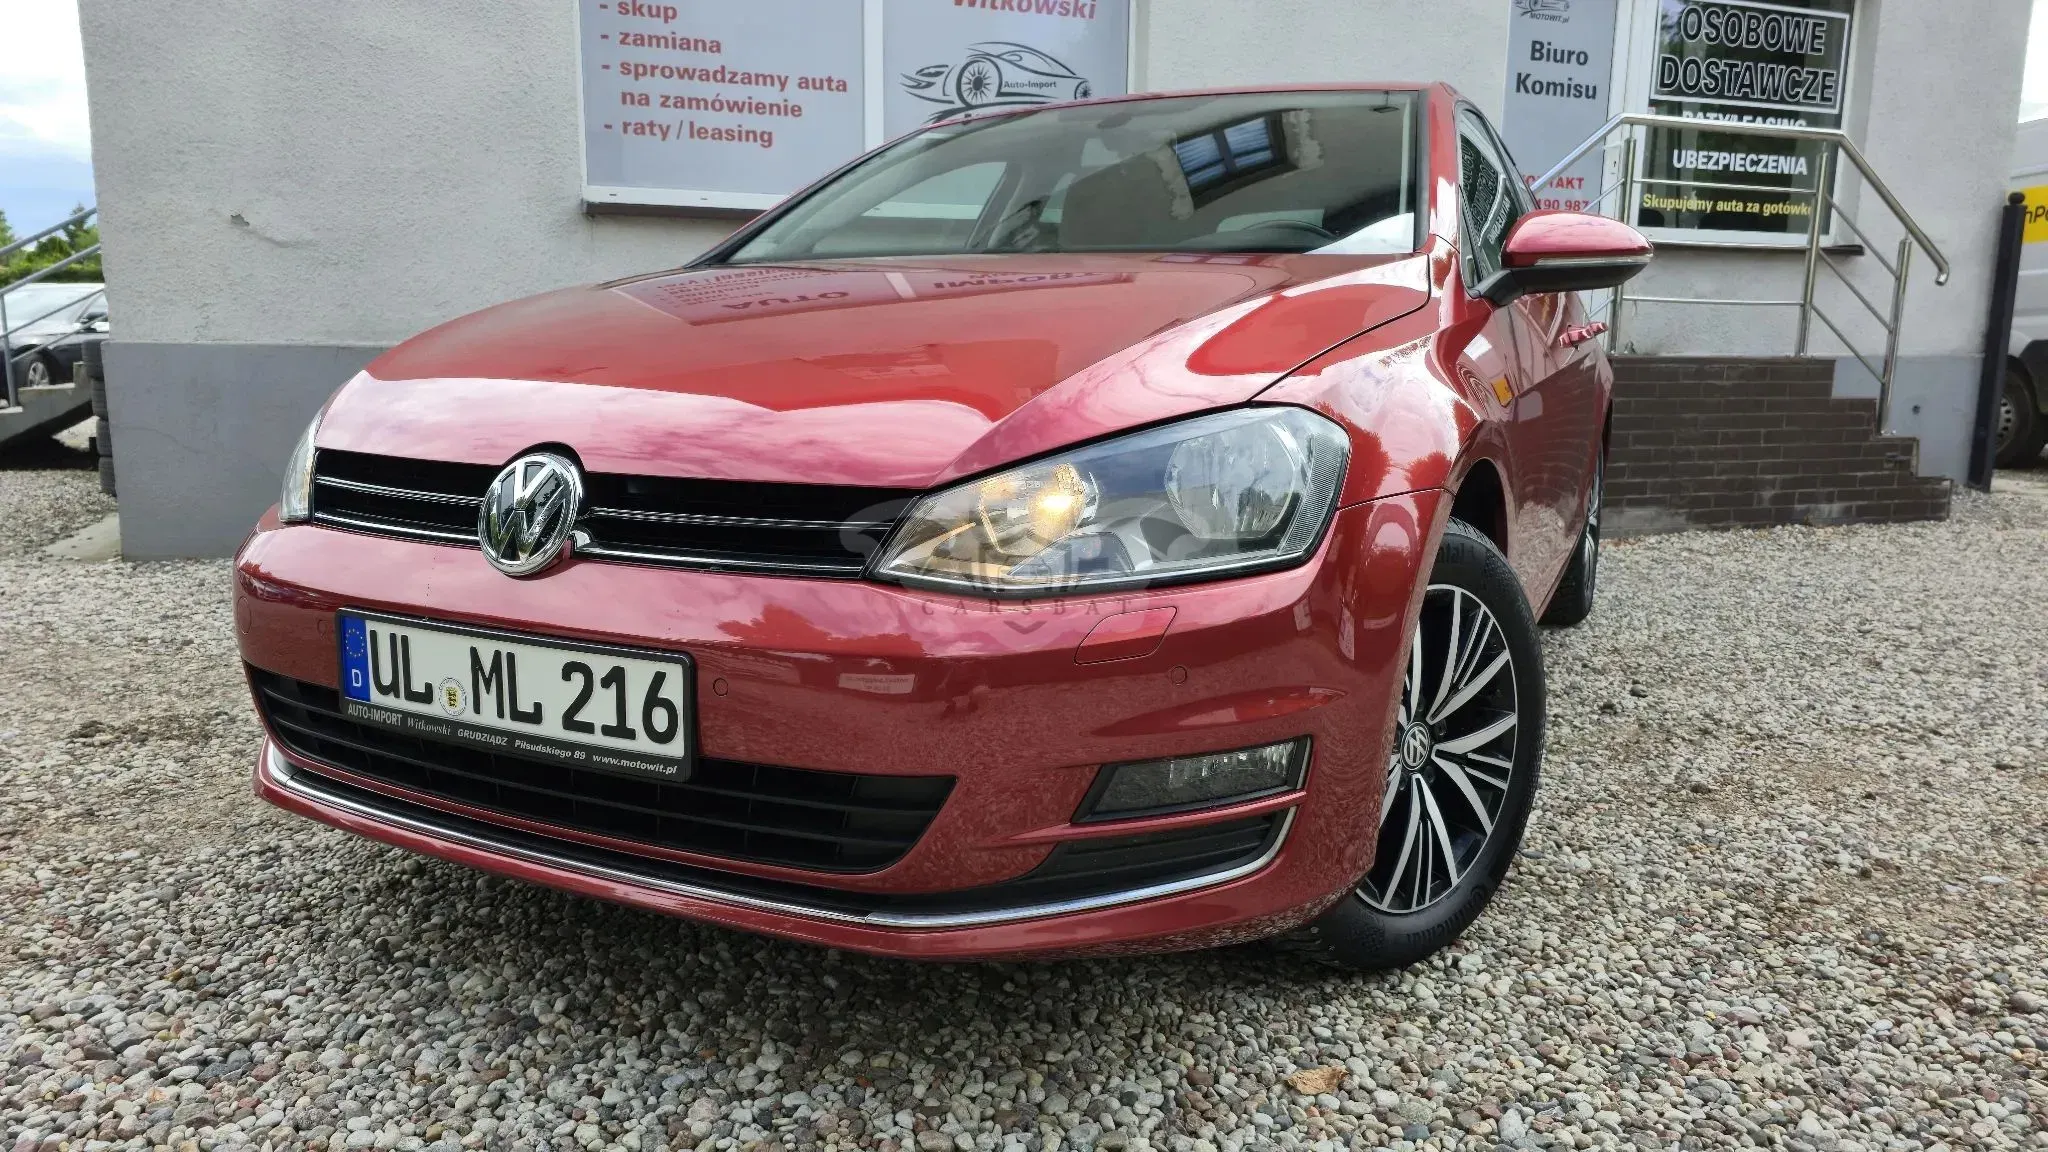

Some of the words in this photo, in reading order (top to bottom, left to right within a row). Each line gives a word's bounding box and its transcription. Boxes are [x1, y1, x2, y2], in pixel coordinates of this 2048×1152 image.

[617, 0, 678, 24] skup
[618, 31, 721, 54] zamiana
[1680, 4, 1828, 56] OSOBOWE
[1530, 40, 1589, 66] Biuro
[619, 60, 789, 92] sprowadzamy
[797, 75, 848, 92] auta
[1003, 80, 1057, 89] Auto-Import
[1515, 72, 1597, 100] Komisu
[1658, 54, 1837, 104] DOSTAWCZE
[620, 90, 650, 106] na
[659, 93, 803, 118] zamówienie
[622, 119, 671, 142] raty
[688, 121, 773, 148] leasing
[1672, 149, 1808, 175] UBEZPIECZENIA
[1643, 193, 1713, 213] Skupujemy
[1716, 199, 1744, 211] auta
[1746, 201, 1760, 213] za
[351, 667, 362, 688] D
[369, 628, 434, 705] UL
[469, 645, 544, 726] ML
[561, 660, 679, 745] 216
[347, 704, 402, 726] AUTO-IMPORT
[407, 717, 451, 736] Witkowski
[457, 728, 509, 746] GRUDZIĄDZ
[514, 739, 572, 759] Piłsudskiego
[573, 750, 586, 760] 89
[592, 754, 678, 775] www.motowit.pl
